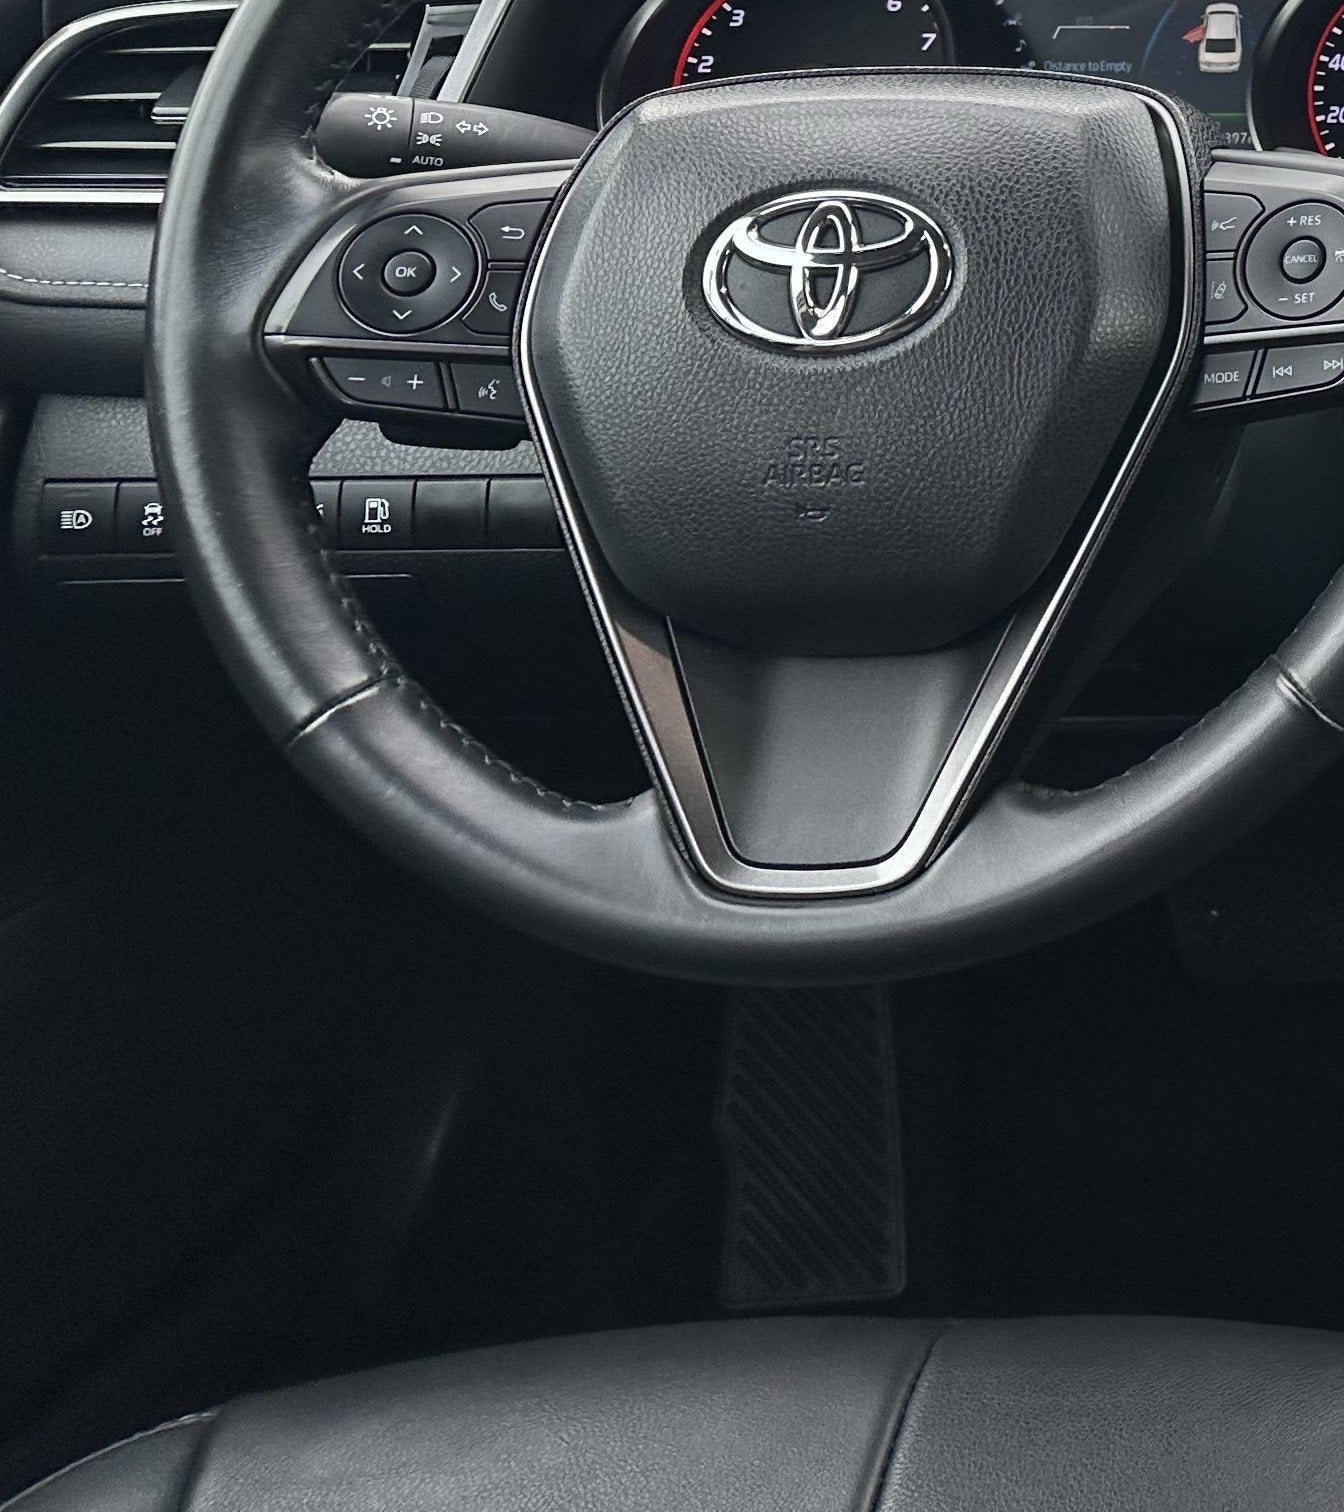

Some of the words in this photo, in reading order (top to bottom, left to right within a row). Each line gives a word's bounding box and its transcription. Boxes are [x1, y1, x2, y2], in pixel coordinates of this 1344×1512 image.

[729, 9, 745, 27] 3
[921, 32, 937, 51] 7
[697, 55, 714, 73] 2
[412, 155, 444, 167] AUTO
[1284, 253, 1318, 265] CANCEL
[395, 266, 417, 278] OK
[1203, 370, 1240, 385] MODE
[788, 438, 841, 462] SRS
[763, 463, 867, 488] AIRBAG
[142, 528, 162, 536] OFF
[361, 524, 392, 534] HOLD
